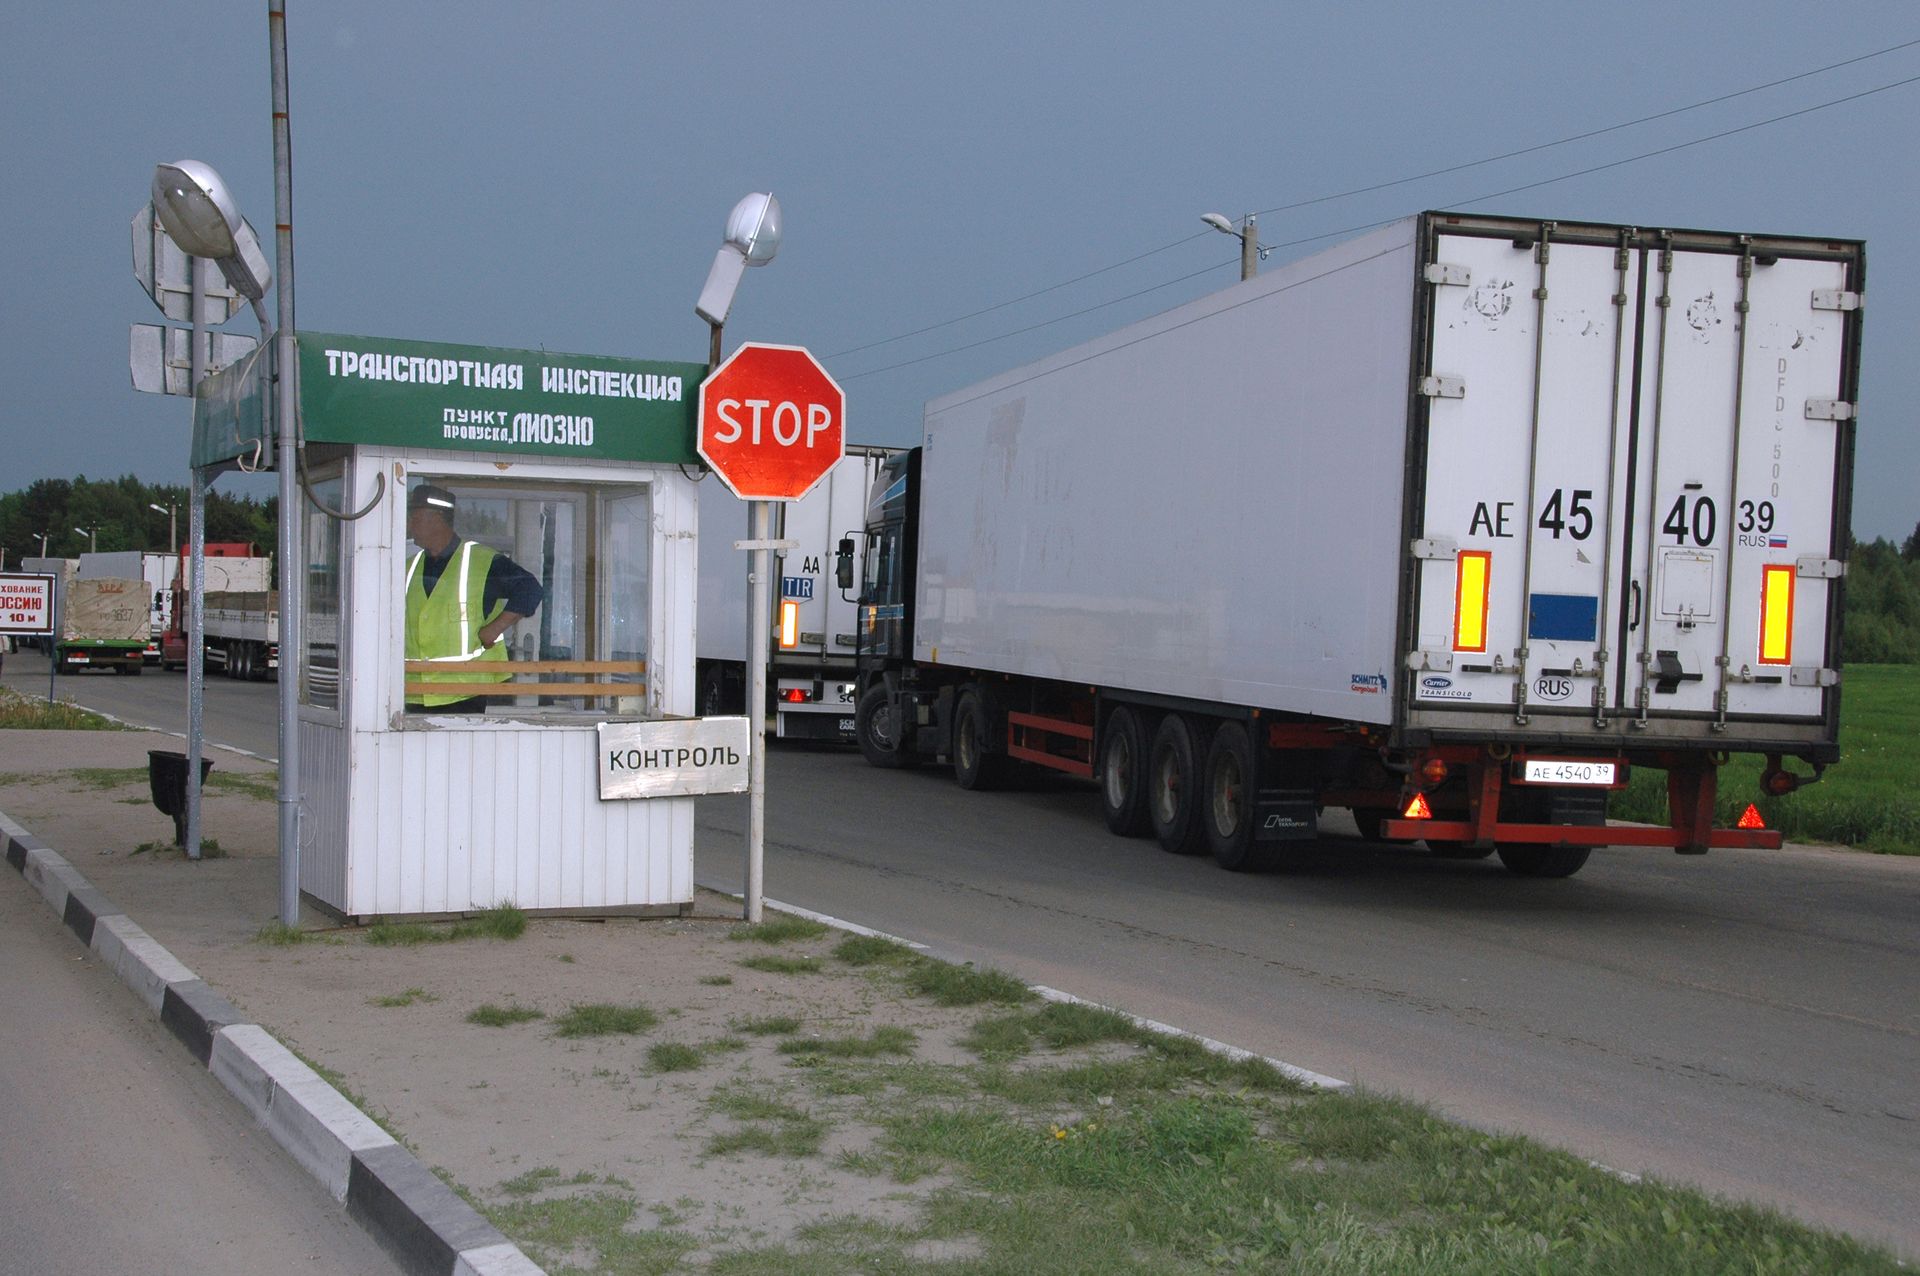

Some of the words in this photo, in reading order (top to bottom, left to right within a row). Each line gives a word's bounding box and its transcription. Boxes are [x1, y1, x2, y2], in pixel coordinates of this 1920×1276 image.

[324, 349, 524, 391] ТРАНСПОРТНАЯ
[542, 366, 683, 402] ИНСПЕКЦИЯ
[443, 408, 508, 425] ПУНКТ
[714, 398, 832, 448] STOP
[1469, 501, 1514, 538] AE
[1538, 488, 1593, 541] 45
[1662, 494, 1717, 547] 40
[1738, 500, 1775, 533] 39
[1738, 534, 1767, 548] RUS
[802, 555, 820, 574] AA
[785, 577, 811, 597] TIR
[9, 613, 25, 622] 10
[1351, 674, 1378, 686] SCHMITZ
[1424, 679, 1449, 688] Carrier
[1538, 679, 1570, 696] RUS
[1421, 689, 1472, 697] TRANSICOLD
[610, 746, 740, 771] КОНТРОЛЬ
[1533, 767, 1550, 779] AE
[1555, 765, 1591, 780] 4540
[1596, 766, 1609, 777] 39
